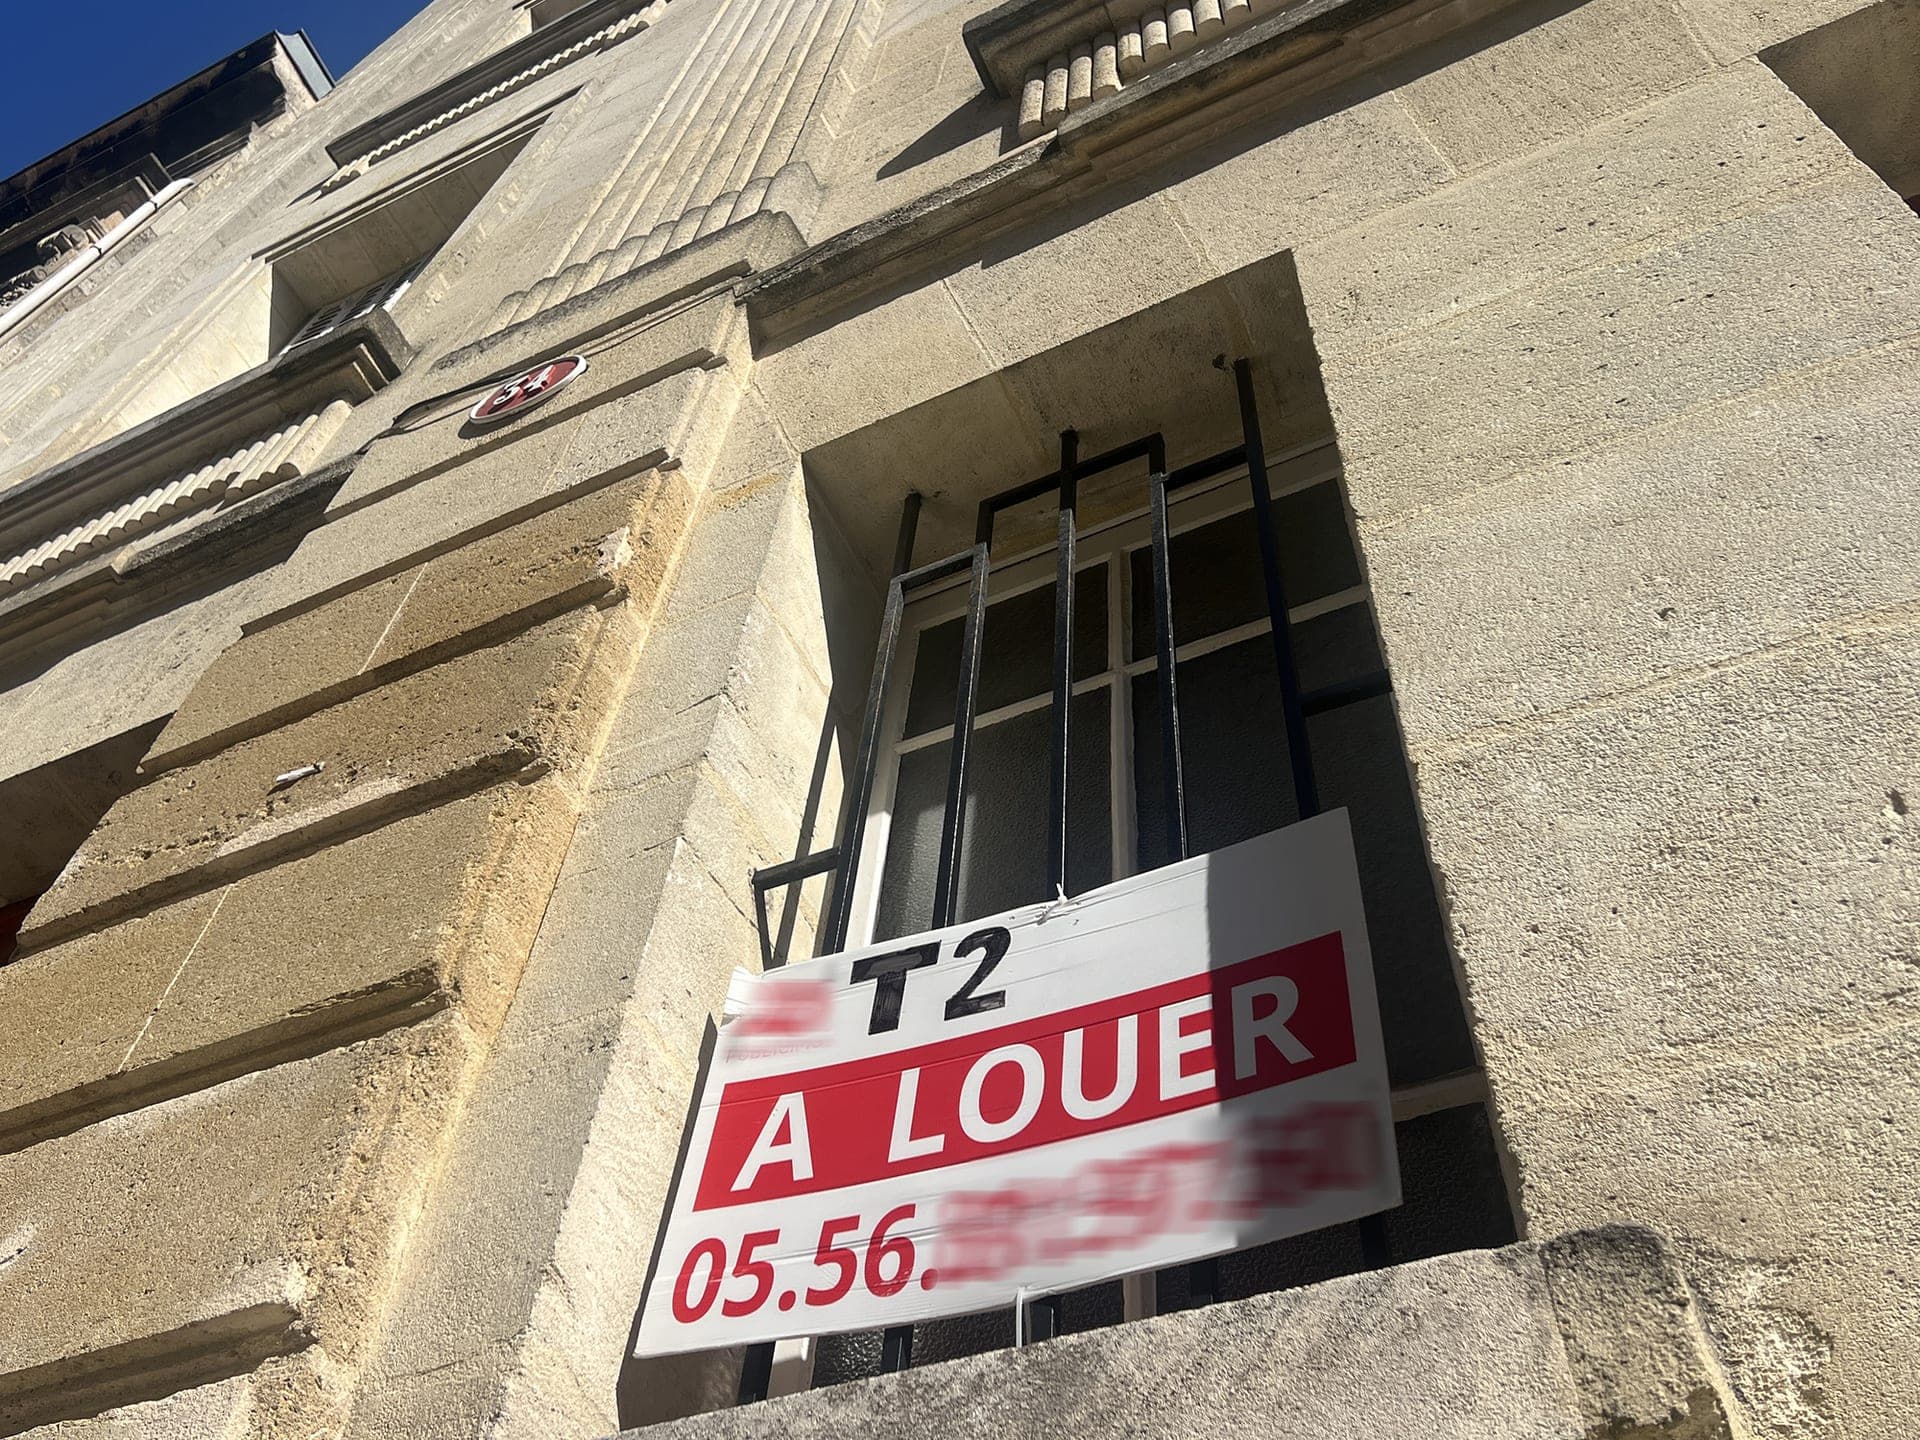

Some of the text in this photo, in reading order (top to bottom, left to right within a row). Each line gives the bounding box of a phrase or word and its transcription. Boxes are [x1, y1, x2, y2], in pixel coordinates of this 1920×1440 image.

[850, 926, 1012, 1035] T2
[731, 1092, 814, 1191] A
[887, 975, 1314, 1162] LOUER
